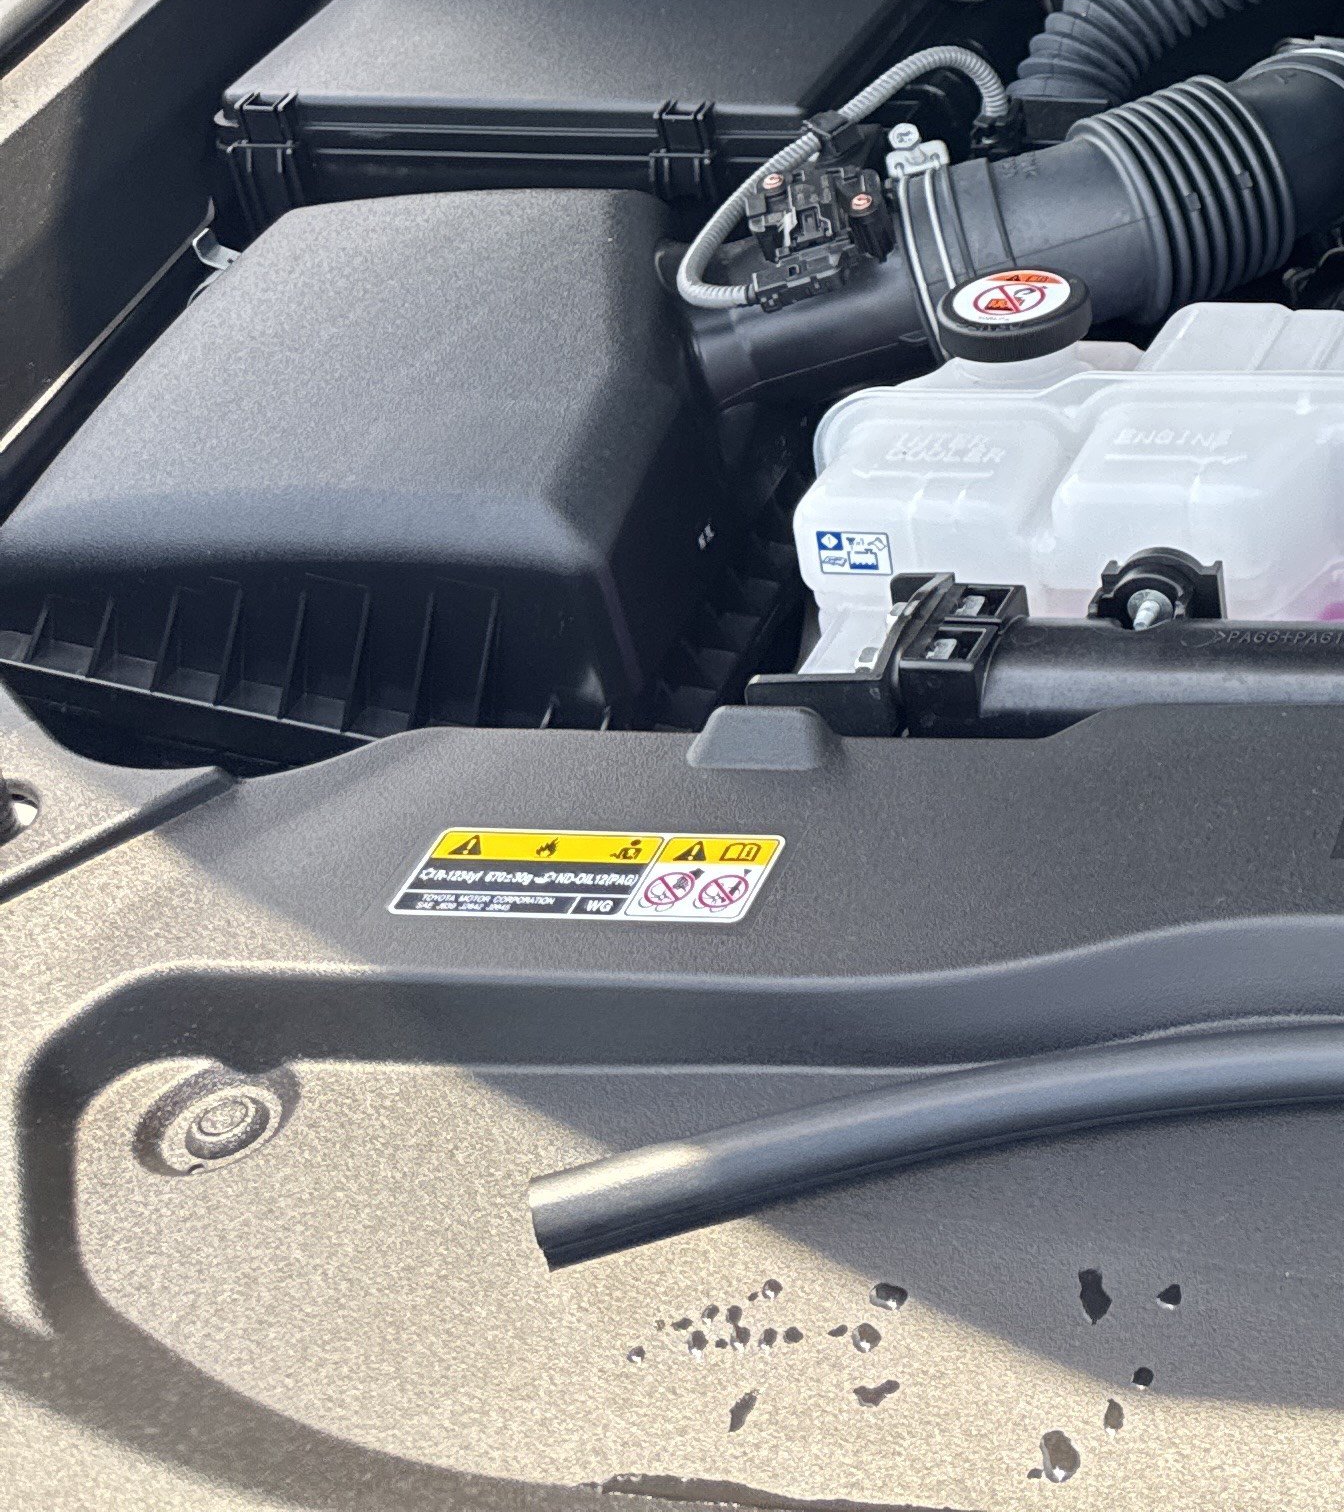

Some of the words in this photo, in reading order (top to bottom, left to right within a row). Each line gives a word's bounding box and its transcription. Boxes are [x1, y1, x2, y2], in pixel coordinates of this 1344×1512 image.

[1113, 428, 1233, 445] ENGINE
[421, 893, 456, 902] TOYOTA
[458, 894, 491, 903] MOTOR
[492, 895, 556, 905] CORPORATION
[586, 899, 614, 912] WG
